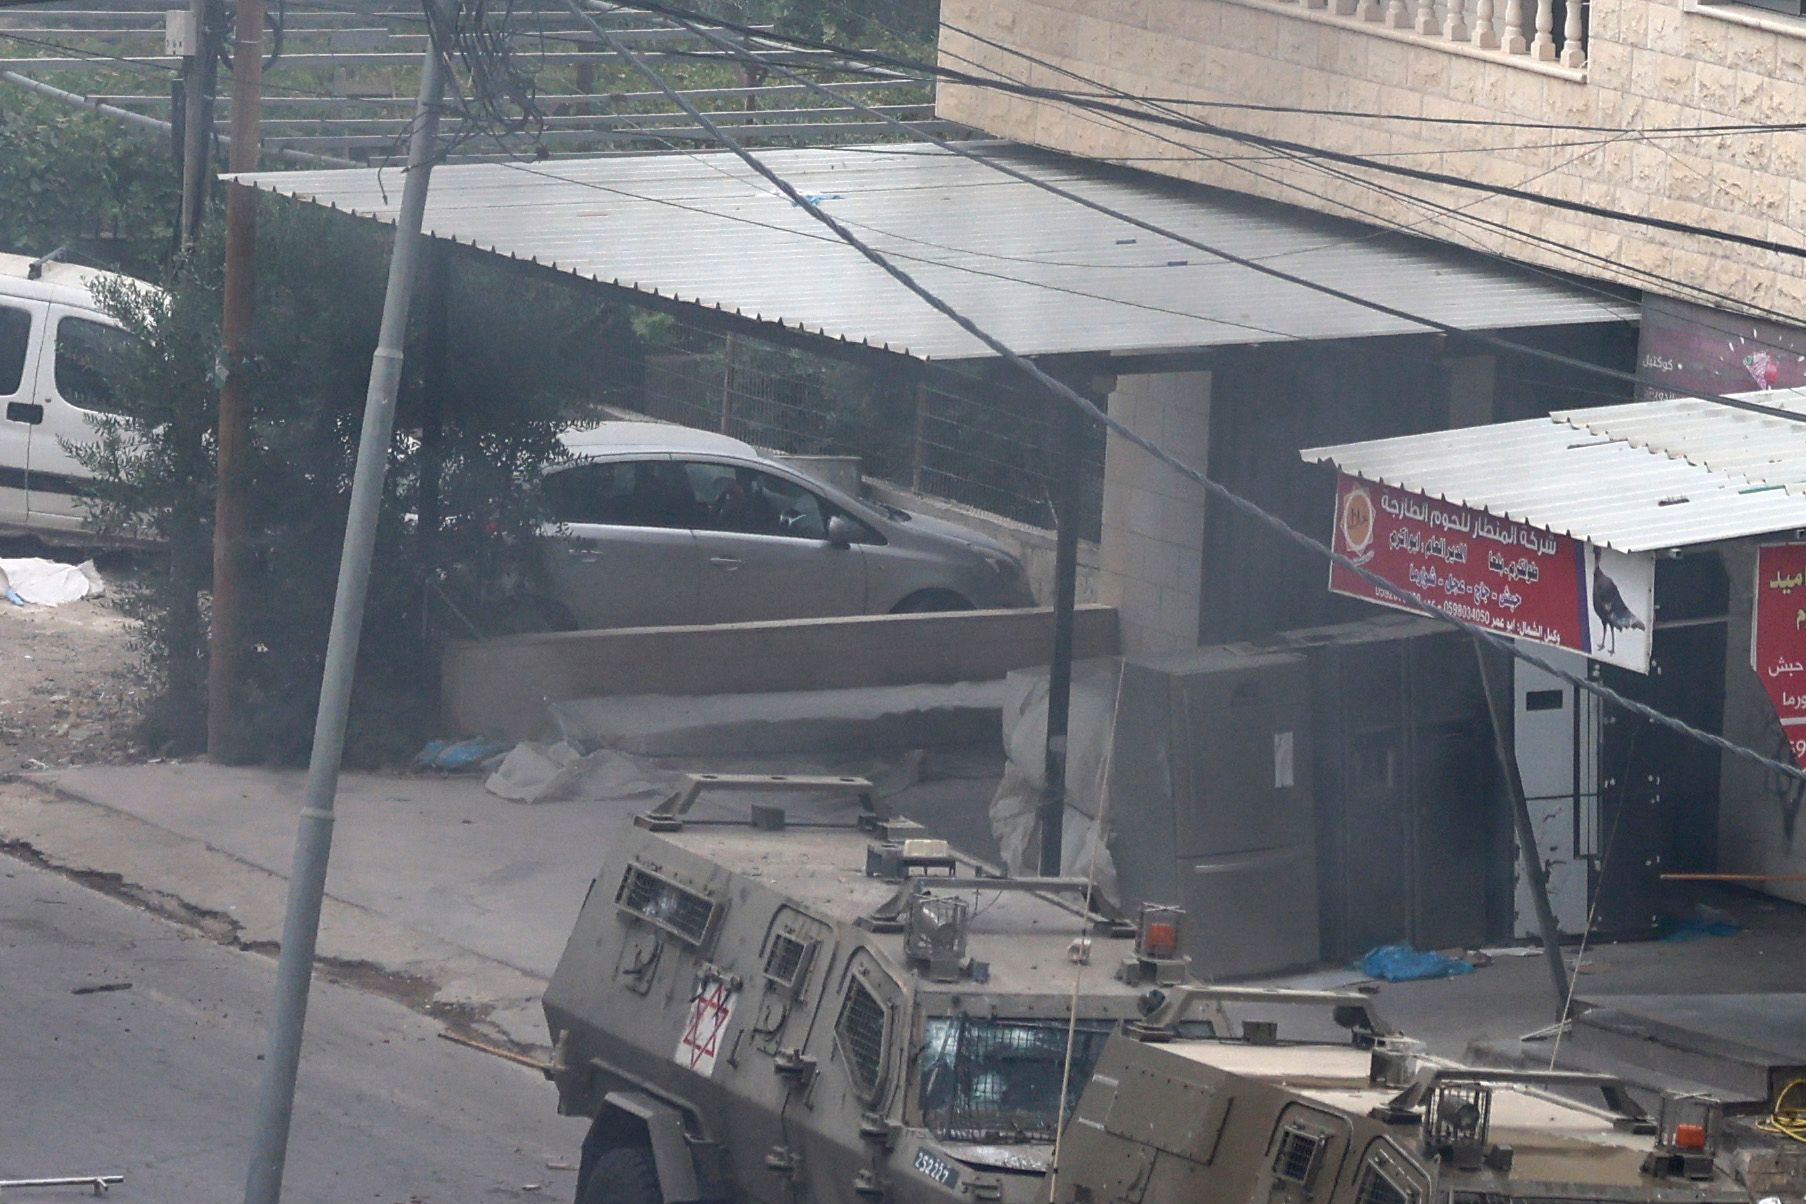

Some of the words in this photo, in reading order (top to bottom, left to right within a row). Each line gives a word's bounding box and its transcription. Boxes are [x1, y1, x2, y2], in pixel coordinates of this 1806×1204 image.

[1431, 511, 1471, 532] للحوم
[1472, 516, 1518, 545] المنطار
[1519, 525, 1557, 556] شركة
[1768, 656, 1804, 677] حبش
